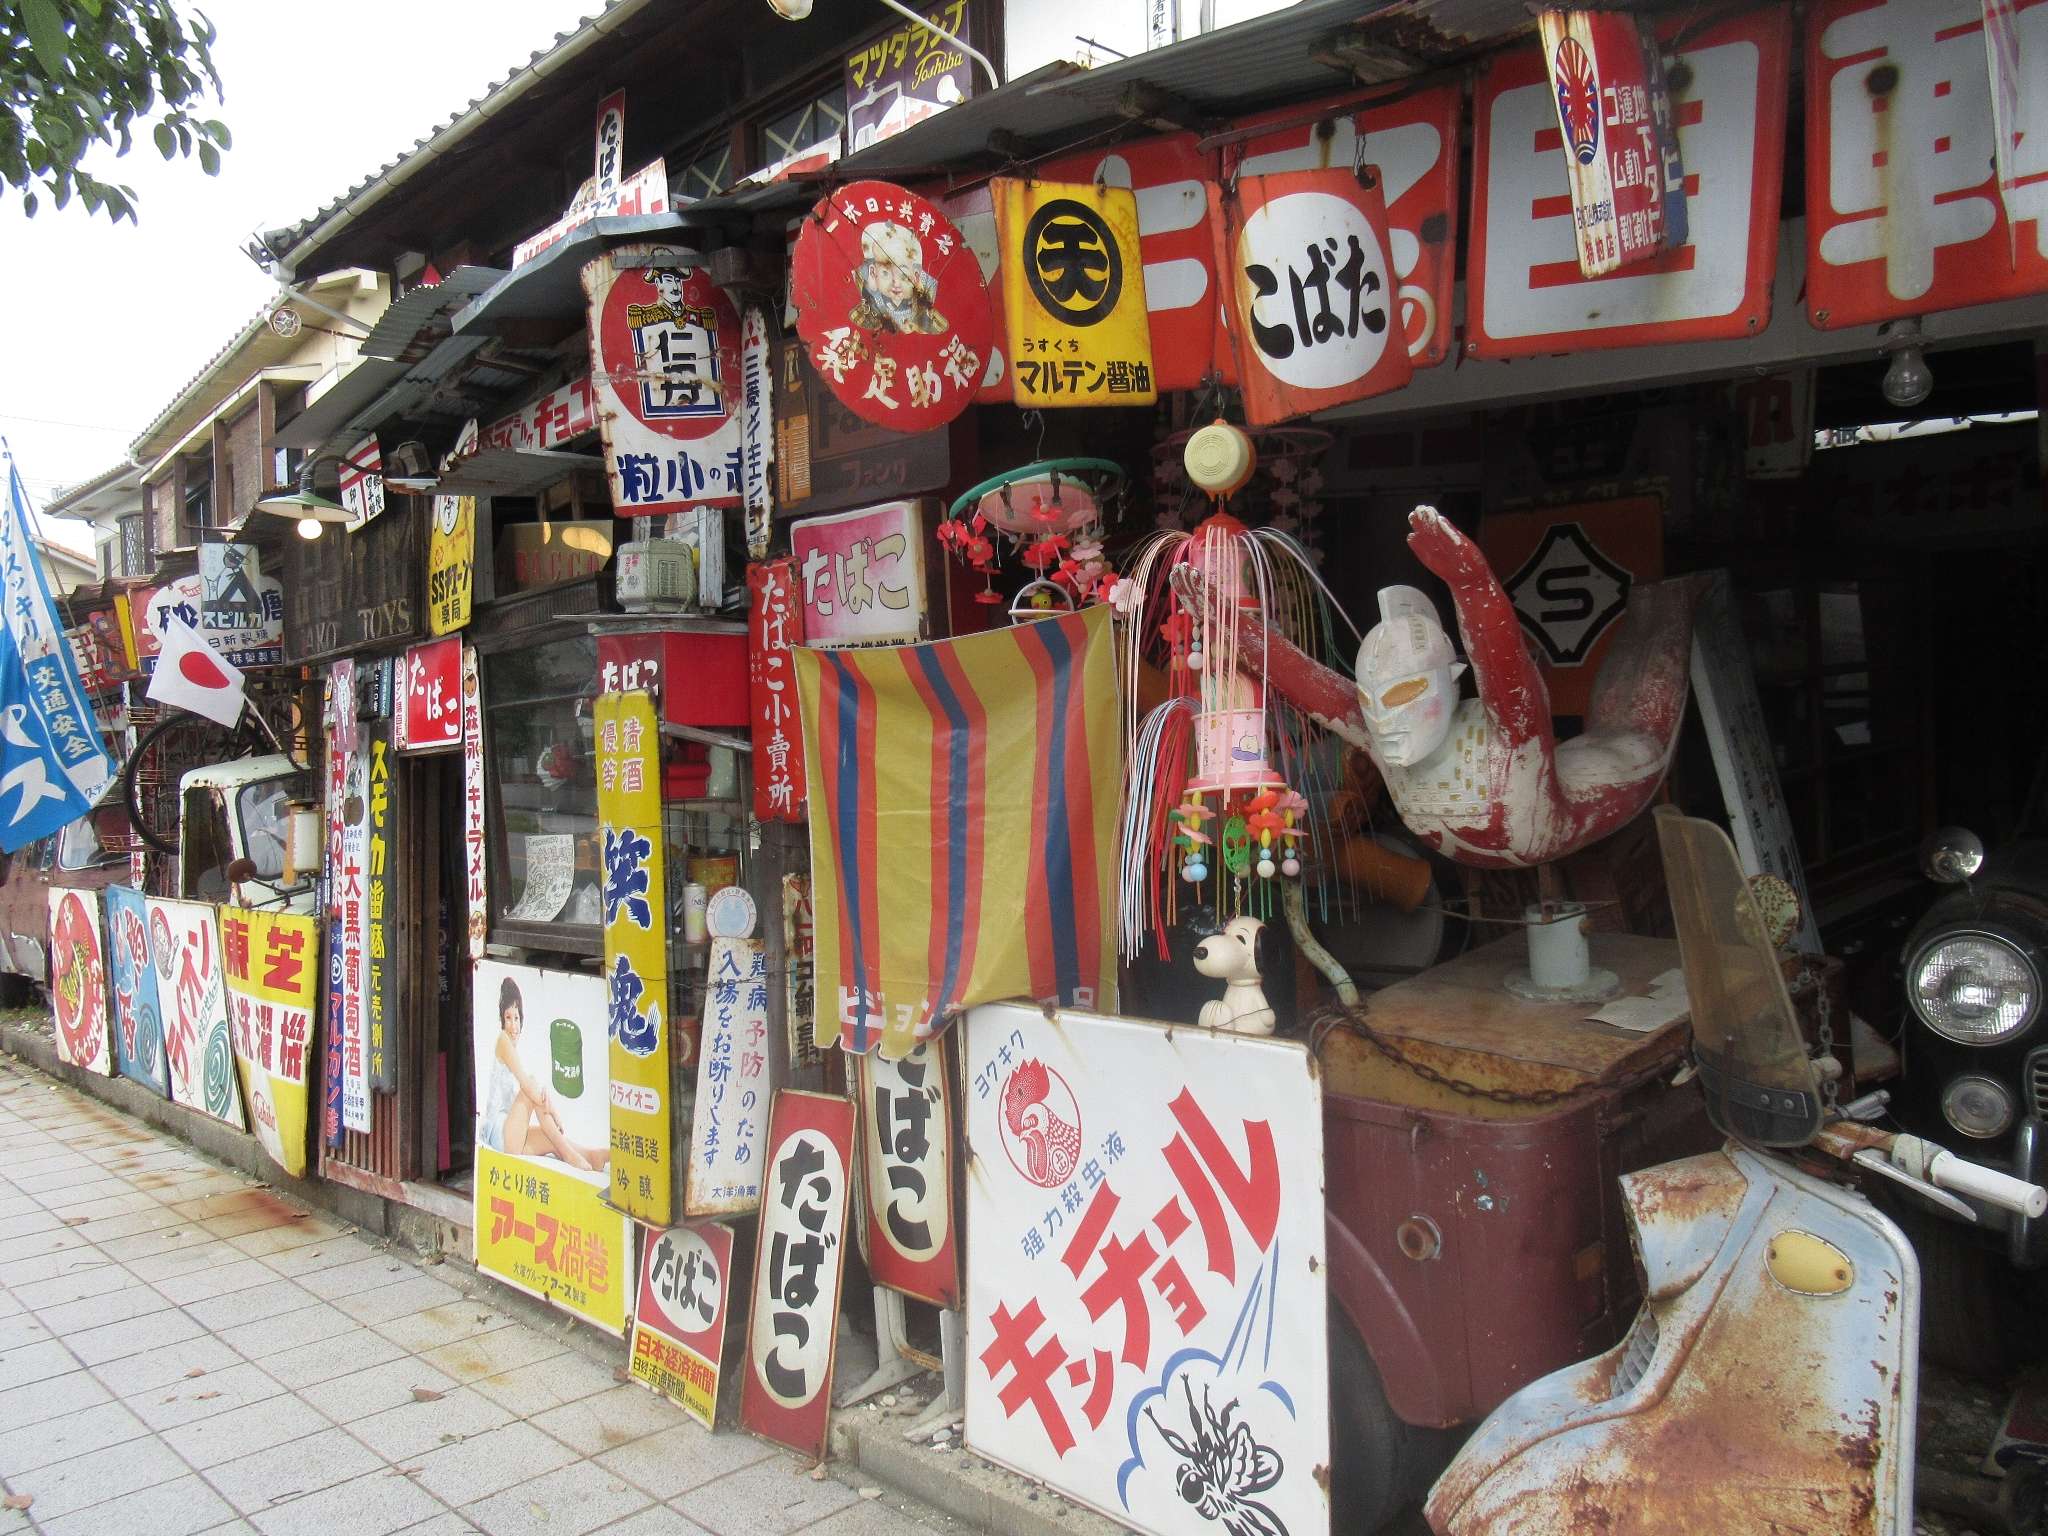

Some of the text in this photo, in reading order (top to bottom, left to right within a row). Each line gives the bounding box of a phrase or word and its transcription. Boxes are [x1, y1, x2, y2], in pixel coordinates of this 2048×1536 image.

[848, 0, 967, 89] マツダランプ
[911, 50, 964, 91] Toshiba
[1244, 233, 1387, 360] たばこ
[1016, 360, 1151, 395] マルテン醤油
[1022, 337, 1079, 353] うすくち
[802, 534, 910, 616] たばこ
[202, 611, 264, 628] スピルカ
[32, 666, 93, 760] 交通安全
[409, 652, 459, 737] たばこ
[602, 659, 659, 697] たばこ
[600, 718, 618, 793] 優等
[621, 715, 644, 793] 清酒
[223, 917, 306, 994] 東芝
[973, 1028, 1027, 1100] ヨクキク
[489, 1165, 551, 1205] かとり線香
[711, 1184, 758, 1200] 大洋漁業
[1020, 1129, 1127, 1261] 強力殺虫液
[490, 1195, 609, 1293] アース渦巻
[651, 1236, 718, 1325] たばこ
[765, 1137, 837, 1399] たばこ
[978, 1085, 1281, 1460] キンチョール
[636, 1331, 716, 1398] 日本経済新聞
